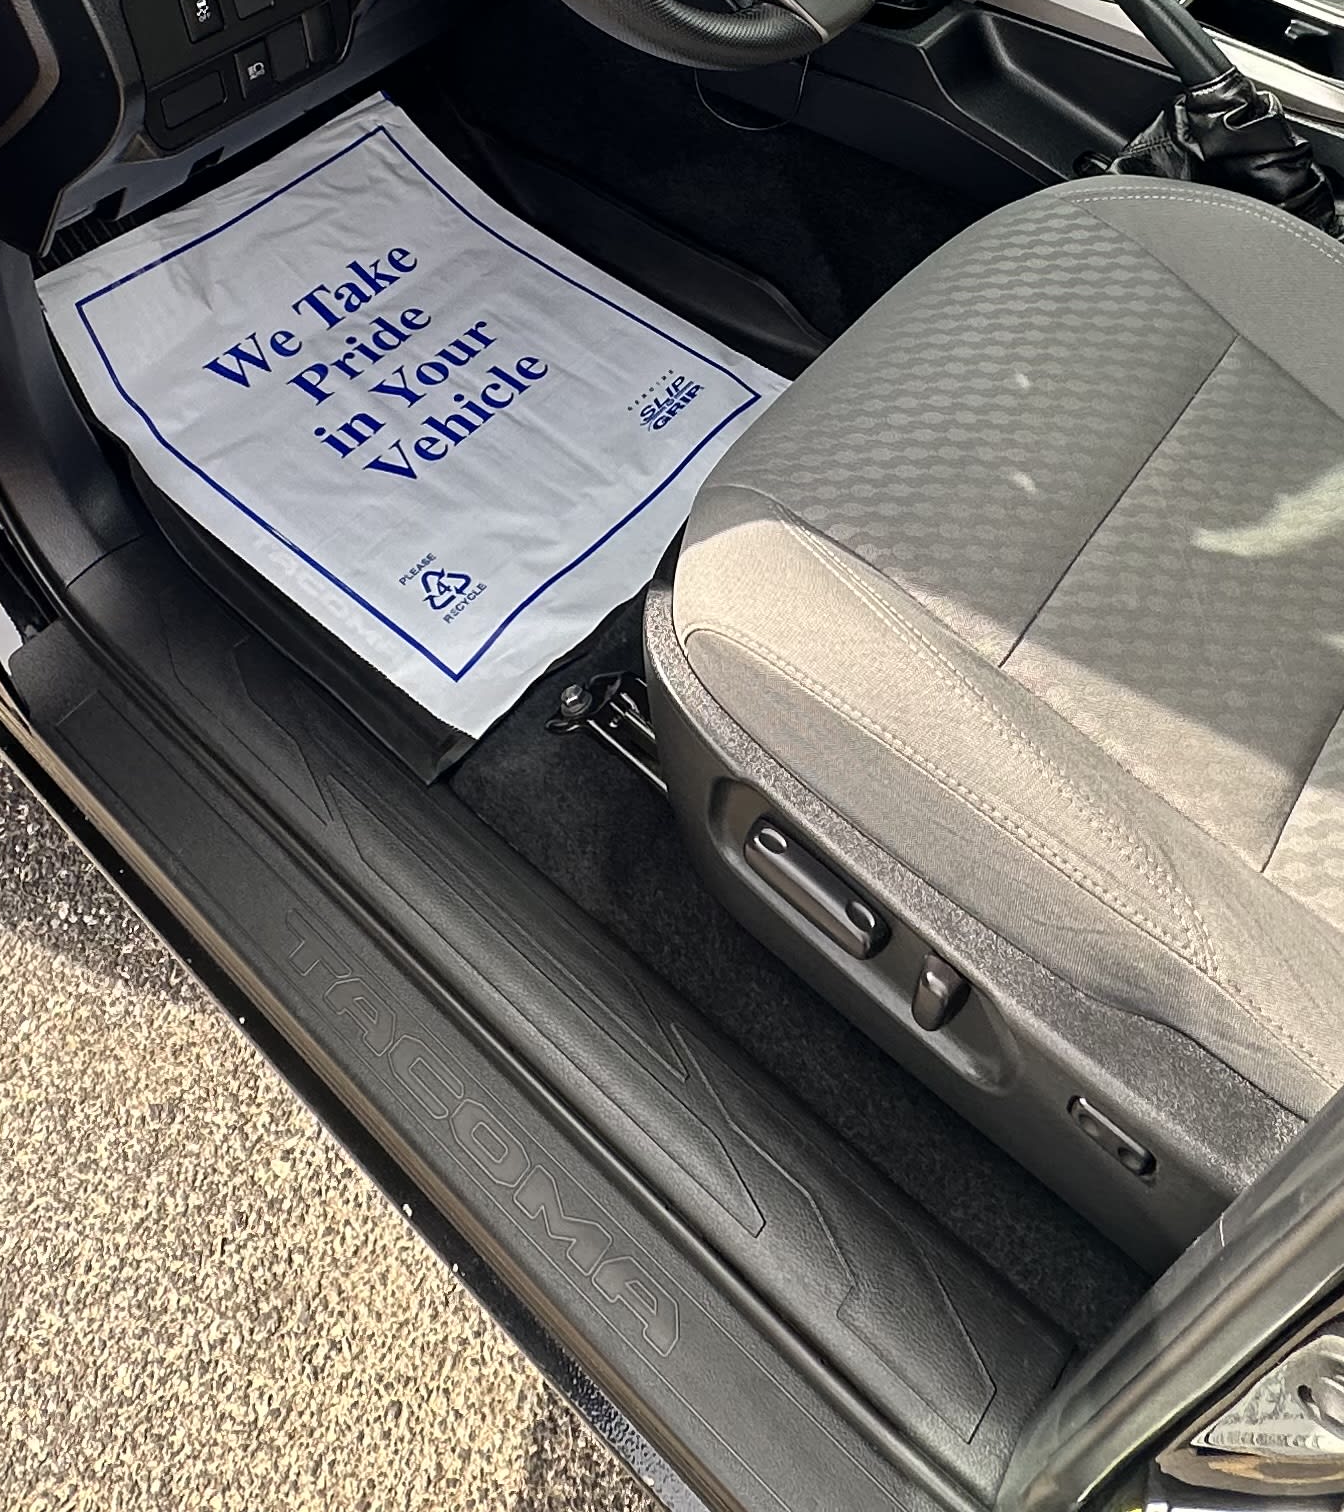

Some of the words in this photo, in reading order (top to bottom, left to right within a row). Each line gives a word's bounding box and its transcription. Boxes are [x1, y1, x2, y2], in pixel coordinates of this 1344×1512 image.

[202, 330, 303, 388] We
[292, 247, 418, 330] Take
[286, 305, 432, 406] Pride
[314, 411, 387, 459] in
[368, 320, 497, 408] Your
[362, 354, 548, 480] Vehicle
[639, 375, 686, 422] SLIP
[652, 384, 701, 430] GRIP
[398, 552, 437, 586] PLEASE
[436, 579, 453, 596] 4
[442, 582, 488, 624] RECYCLE
[286, 909, 681, 1357] TACOMA
